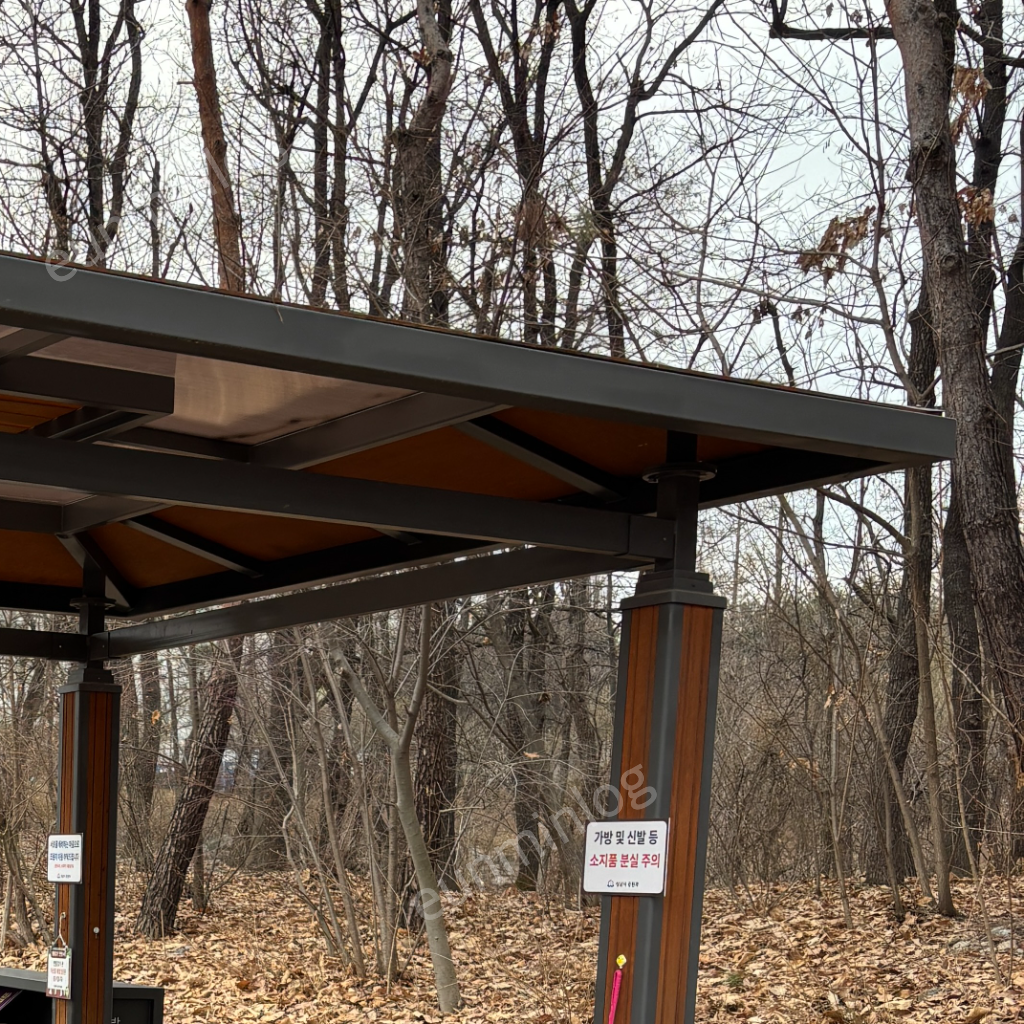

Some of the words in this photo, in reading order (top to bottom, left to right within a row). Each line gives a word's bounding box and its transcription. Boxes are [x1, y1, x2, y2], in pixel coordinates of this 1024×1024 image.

[594, 830, 613, 845] 가방
[615, 830, 625, 845] 및
[627, 830, 646, 845] 신발
[648, 830, 658, 845] 등
[589, 853, 617, 868] 소지품
[619, 853, 639, 868] 분실
[641, 853, 660, 868] 주의
